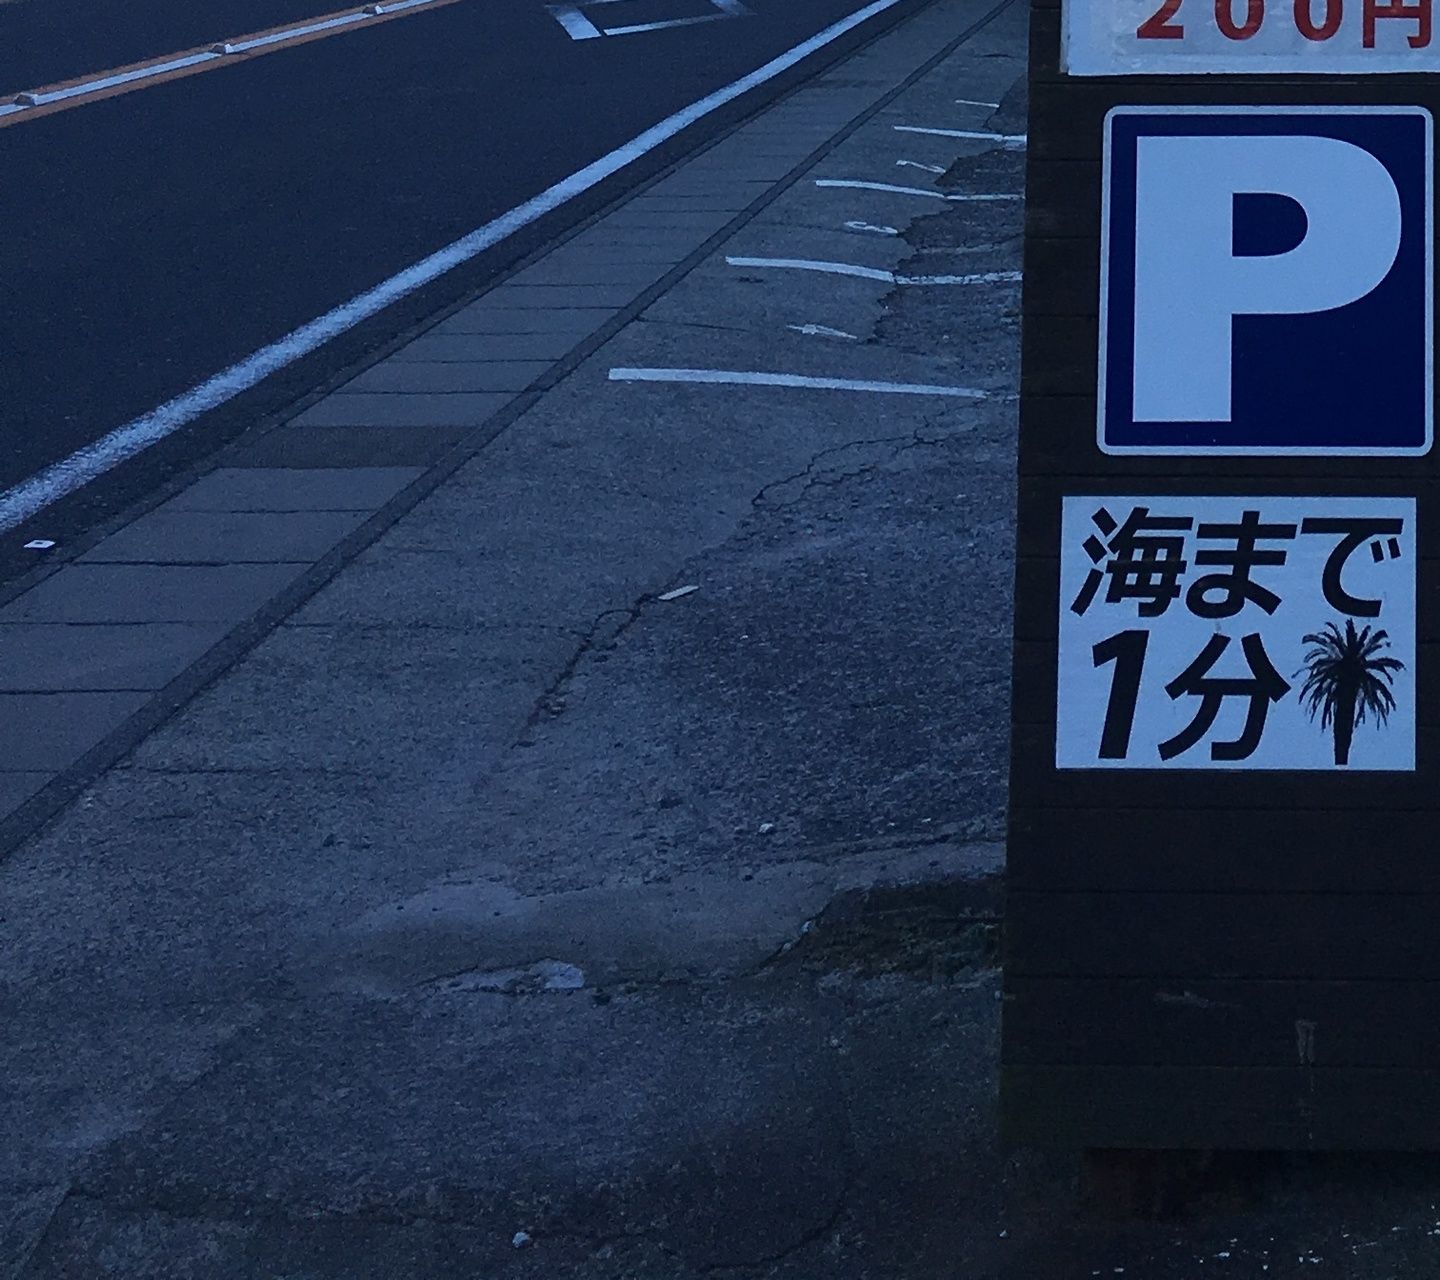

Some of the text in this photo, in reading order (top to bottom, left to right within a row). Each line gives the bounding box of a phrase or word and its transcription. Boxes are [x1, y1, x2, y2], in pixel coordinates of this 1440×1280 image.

[1132, 135, 1401, 422] P
[1071, 507, 1404, 618] 海まで
[1091, 630, 1291, 760] 1分
